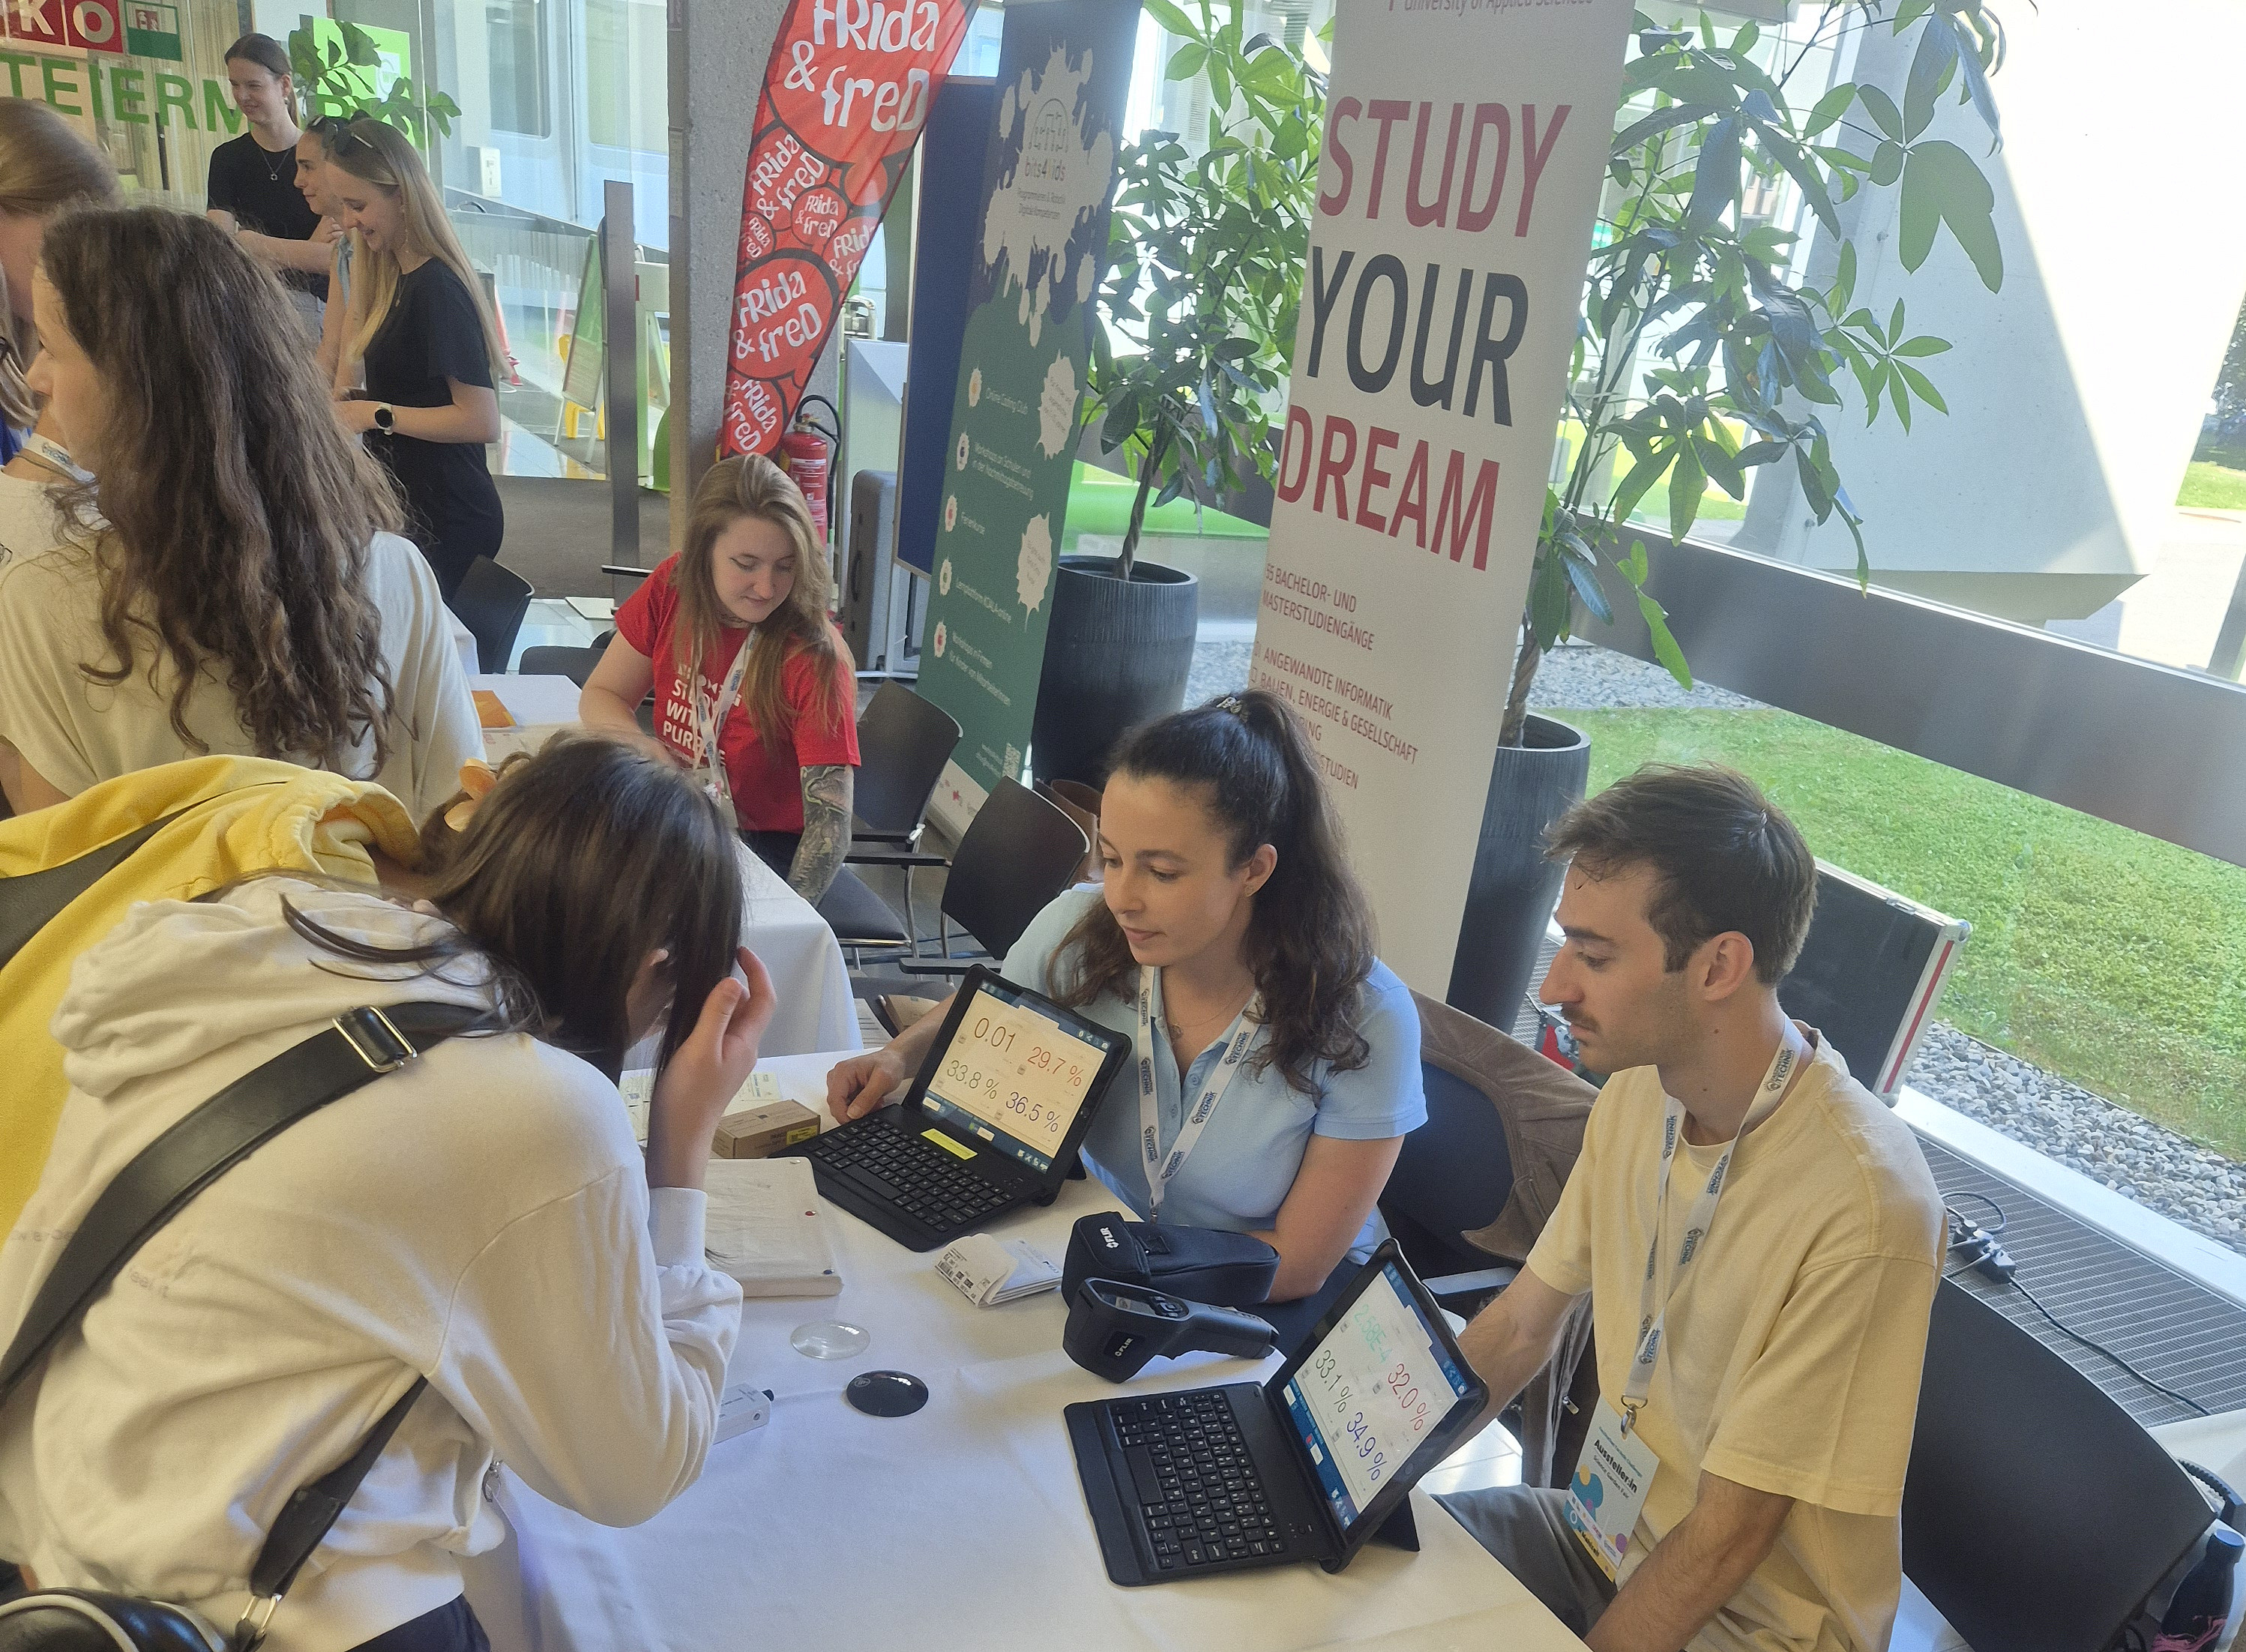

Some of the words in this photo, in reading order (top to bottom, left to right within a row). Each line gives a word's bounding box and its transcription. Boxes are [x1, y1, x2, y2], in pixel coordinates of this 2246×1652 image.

[784, 40, 819, 92] &
[1319, 96, 1573, 238] STUDY
[756, 197, 780, 221] &
[833, 224, 876, 259] FRid
[733, 329, 756, 360] &
[1306, 245, 1531, 428] YOUR
[1277, 405, 1502, 572] DREAM
[1275, 567, 1331, 603] BACHELOR-
[1333, 588, 1357, 613] UND
[1262, 588, 1375, 651] MASTERSTUDIENGÄNGE
[1264, 648, 1334, 691] ANGEWANDTE
[1334, 676, 1394, 721] INFORMATIK
[1298, 689, 1342, 723] ENERGIE
[1341, 710, 1349, 727] &
[1350, 714, 1418, 765] GESELLSCHAFT
[974, 1017, 1017, 1053] 0.01
[947, 1060, 982, 1090] 33.8
[983, 1078, 1000, 1100] %
[1027, 1046, 1067, 1075] 29.7
[1067, 1065, 1085, 1087] %
[1776, 1048, 1794, 1084] TECHNIK
[1005, 1091, 1044, 1121] 36.5
[1044, 1110, 1062, 1133] %
[1646, 1330, 1661, 1360] TECHNIK
[1316, 1349, 1343, 1392] 33.1
[1334, 1385, 1354, 1414] %
[1388, 1363, 1419, 1409] 32.0
[1410, 1402, 1431, 1431] %
[1346, 1411, 1377, 1459] 34.9
[1367, 1451, 1388, 1481] %
[1594, 1438, 1638, 1495] Aussteller:in
